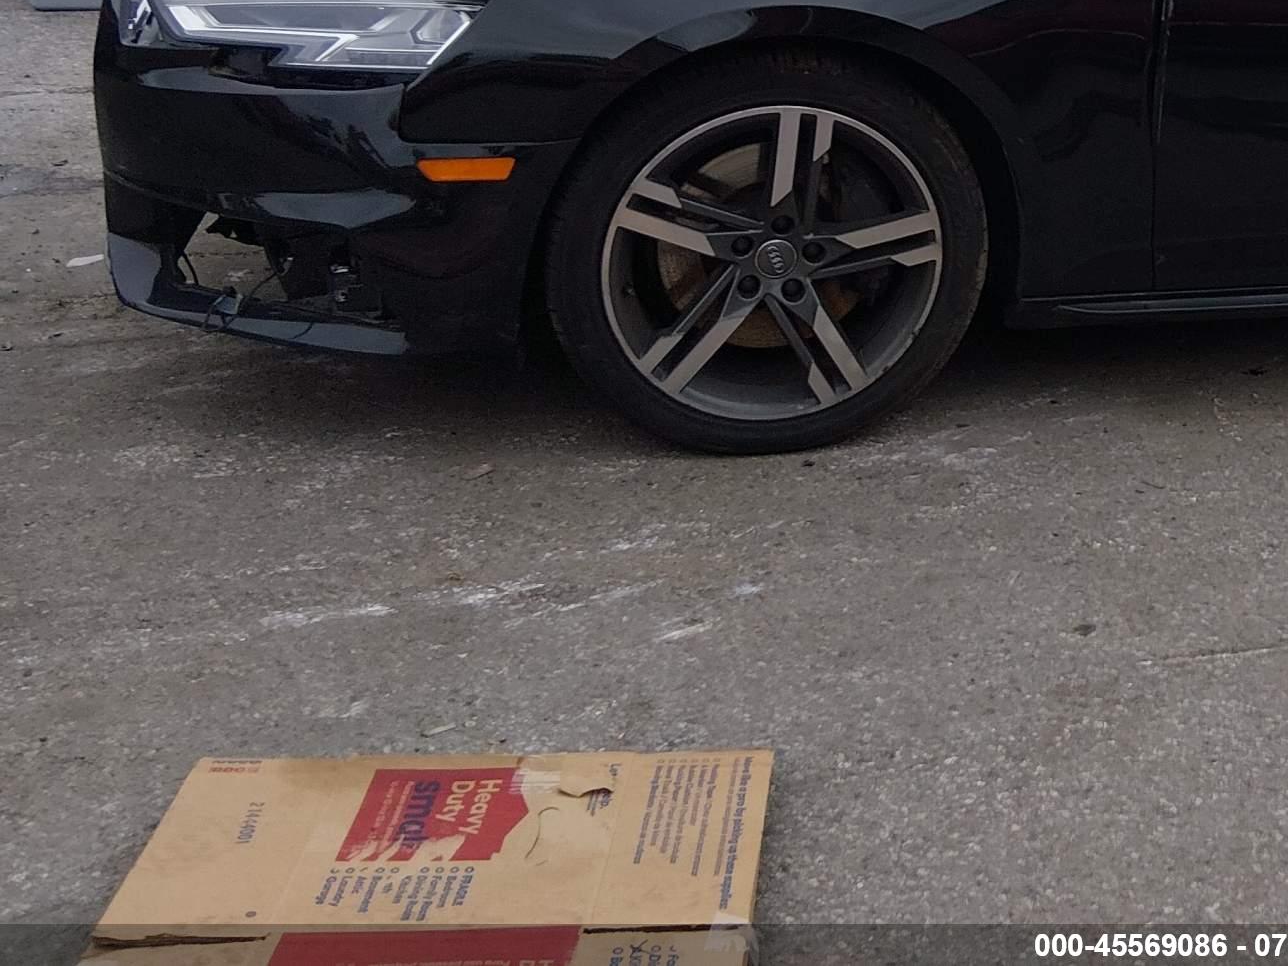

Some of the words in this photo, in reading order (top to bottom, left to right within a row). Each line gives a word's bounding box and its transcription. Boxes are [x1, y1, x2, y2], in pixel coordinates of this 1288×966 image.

[436, 780, 476, 822] Duty
[458, 779, 502, 834] Heavy
[328, 876, 352, 906] Laundry
[407, 875, 428, 899] Dining
[422, 875, 443, 899] Family
[451, 875, 473, 906] FRAGILE
[400, 900, 418, 921] Room
[416, 901, 432, 921] Room
